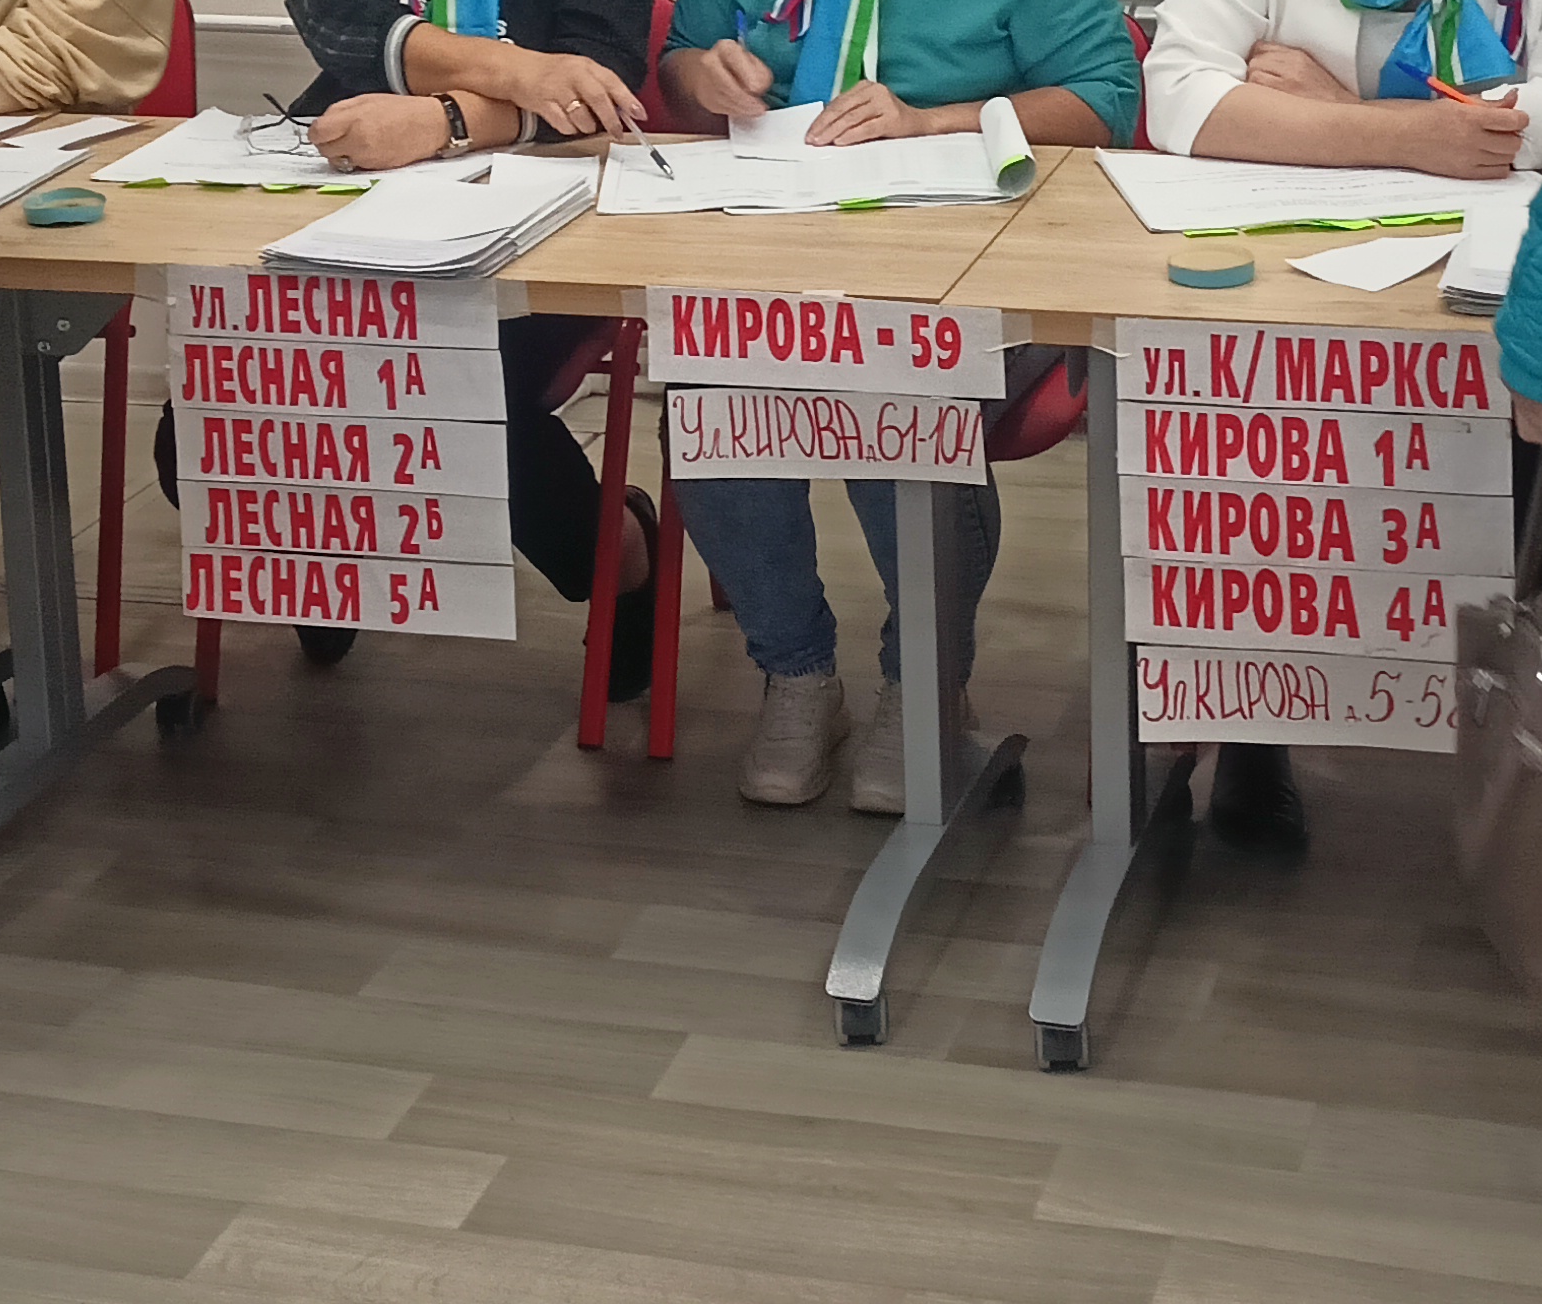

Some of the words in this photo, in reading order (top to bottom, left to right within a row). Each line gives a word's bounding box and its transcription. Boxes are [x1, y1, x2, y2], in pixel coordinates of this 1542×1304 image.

[245, 273, 418, 341] ЛЕСНАЯ
[672, 294, 865, 365] КИРОВА
[910, 313, 962, 371] 59
[182, 343, 348, 409] ЛЕСНАЯ
[200, 416, 371, 483] ЛЕСНАЯ
[727, 395, 864, 462] КИРОВА
[1144, 409, 1350, 485] КИРОВА
[205, 487, 379, 554] ЛЕСНАЯ
[1147, 486, 1356, 563] КИРОВА
[185, 553, 361, 622] ЛЕСНАЯ
[1151, 563, 1361, 640] КИРОВА
[1194, 659, 1330, 721] КИРОВА
